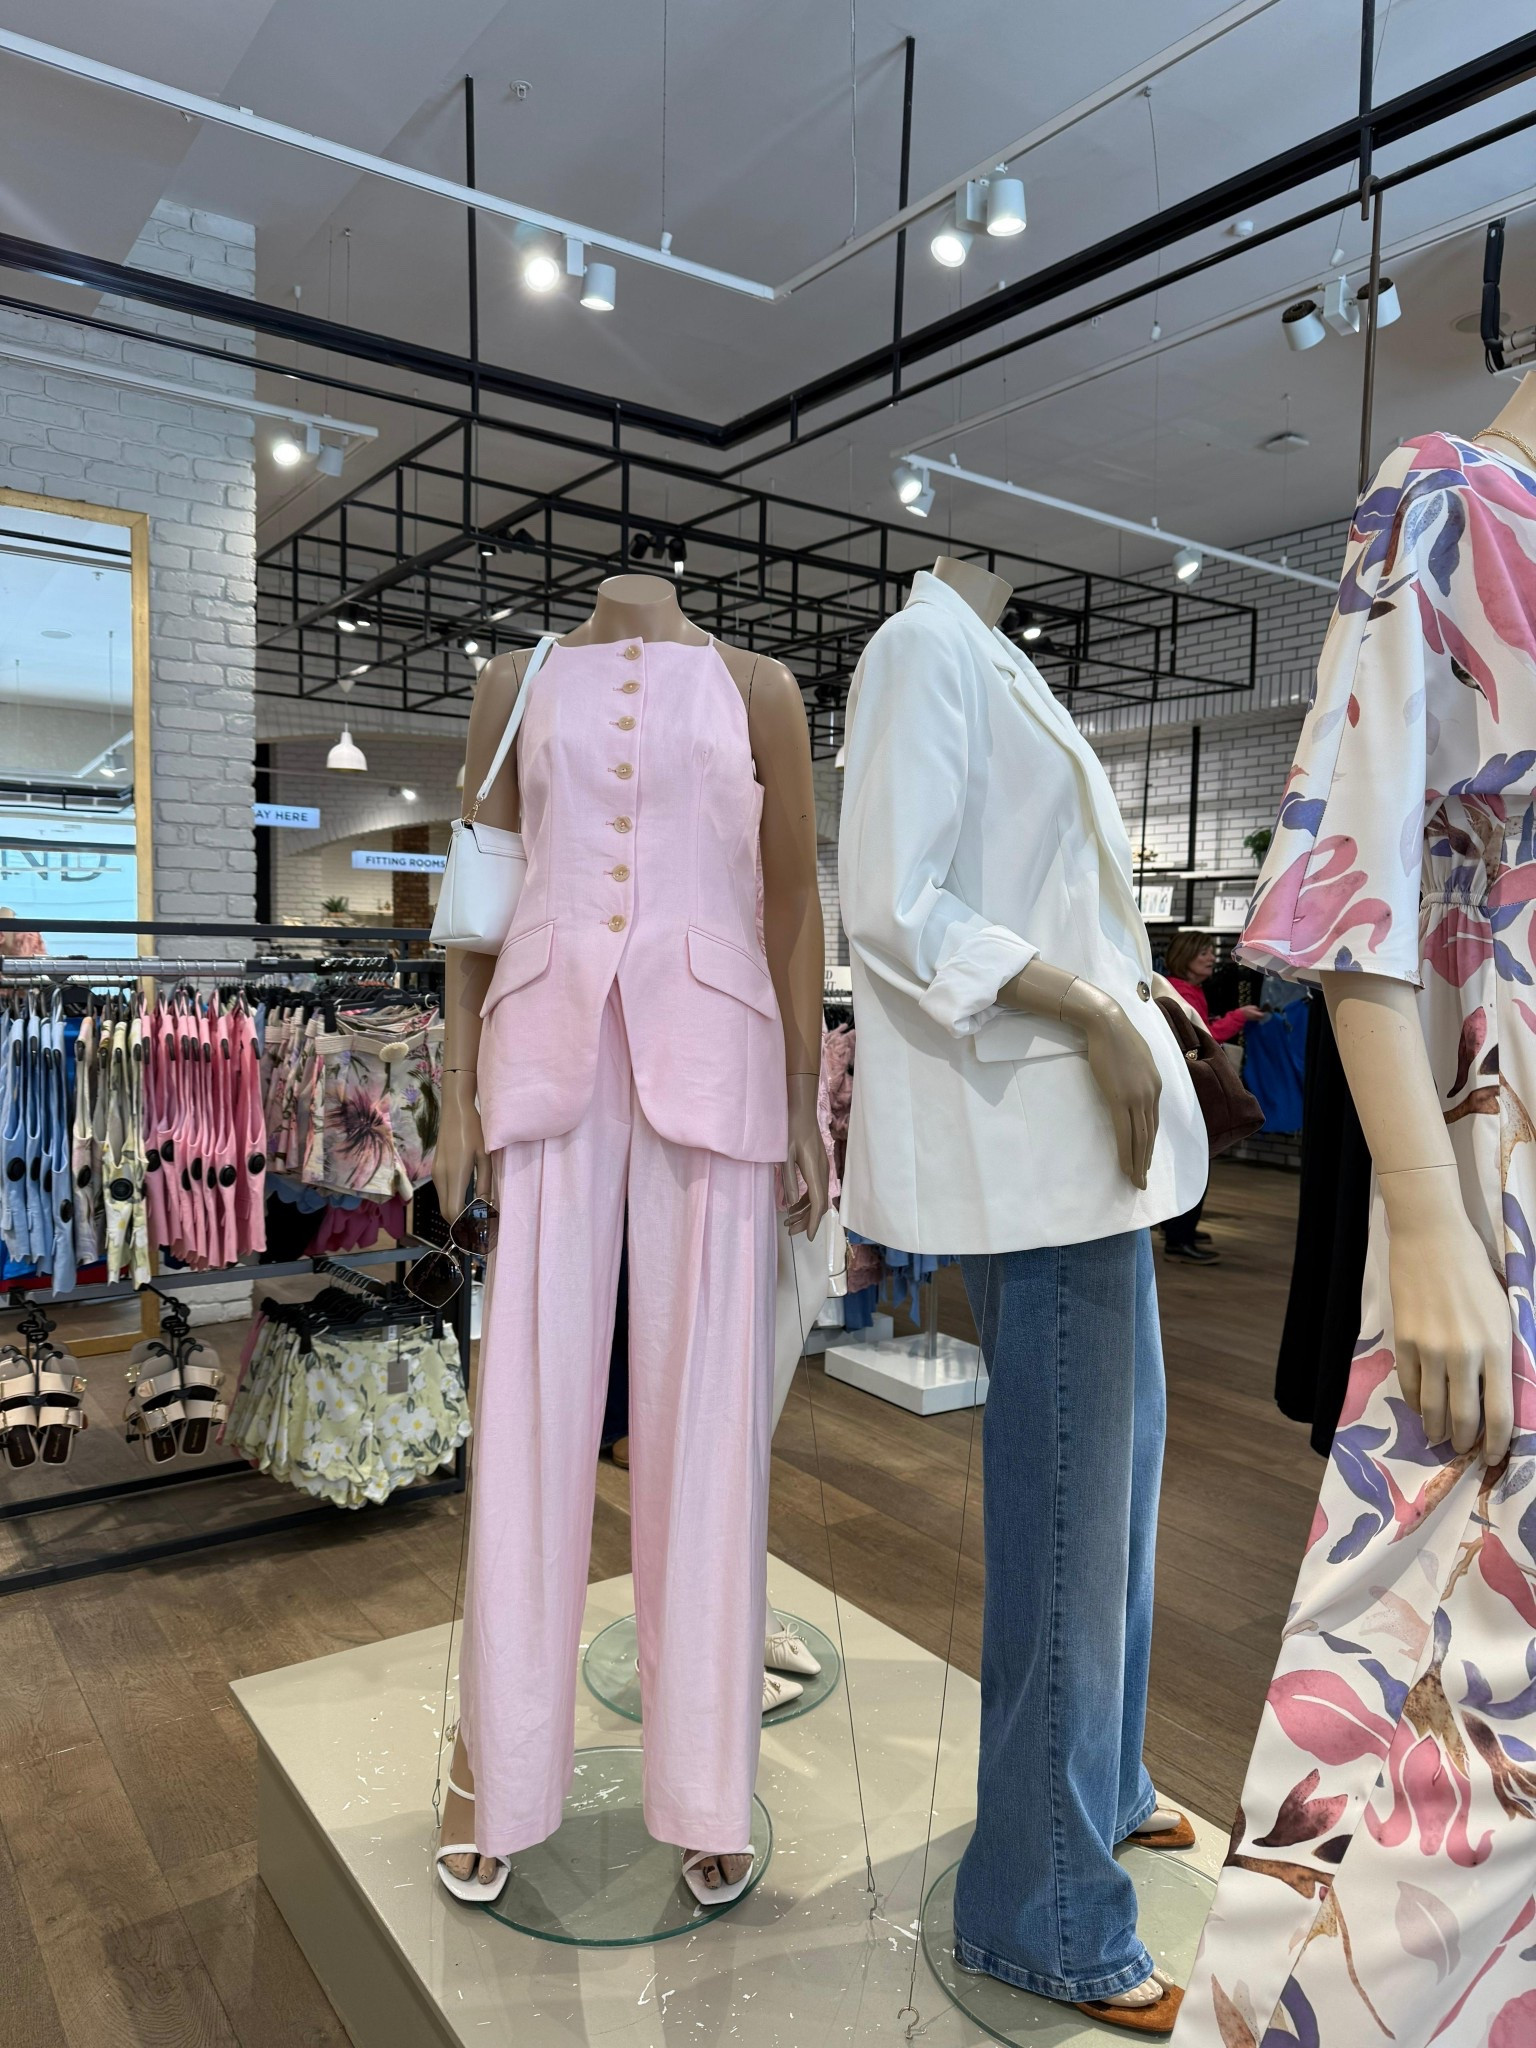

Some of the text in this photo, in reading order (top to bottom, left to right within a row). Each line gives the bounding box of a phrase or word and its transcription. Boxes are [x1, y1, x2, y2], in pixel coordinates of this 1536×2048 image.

[255, 809, 309, 822] AY HERE
[365, 855, 446, 868] FITTING ROOMS
